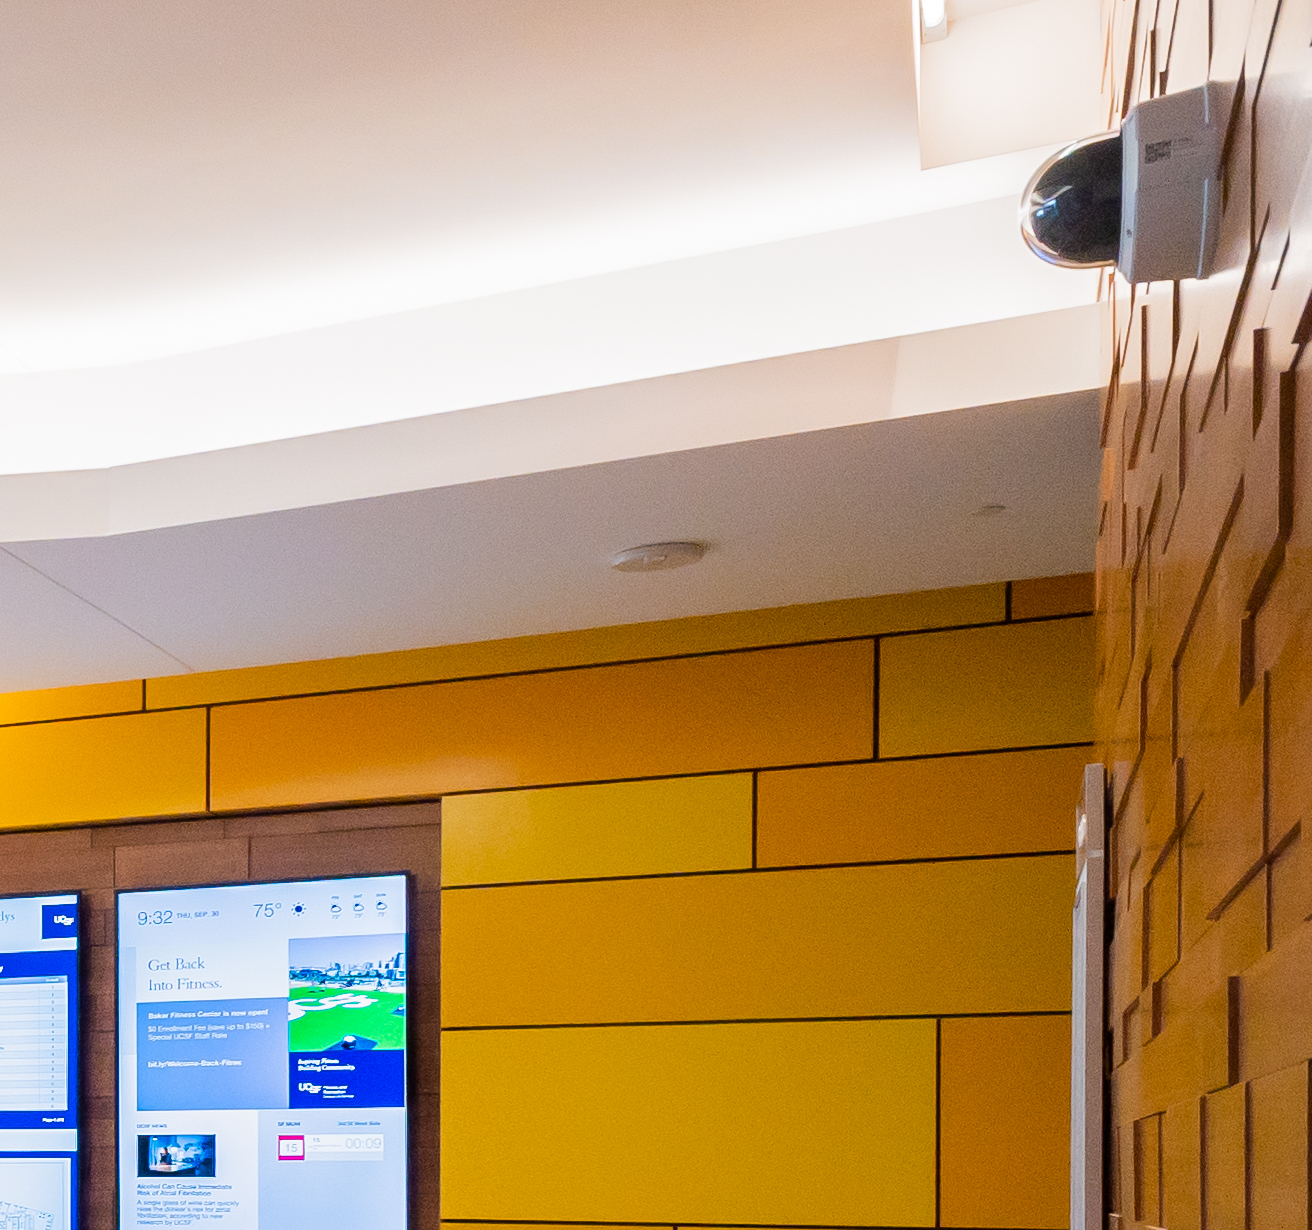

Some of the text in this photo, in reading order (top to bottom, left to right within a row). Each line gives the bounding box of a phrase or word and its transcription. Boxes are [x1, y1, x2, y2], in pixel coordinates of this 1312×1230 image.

[253, 902, 282, 918] 75°
[138, 910, 173, 926] 9:32
[148, 957, 206, 971] Get Back
[149, 978, 222, 991] Into Fitness.
[286, 1144, 298, 1153] 15
[345, 1138, 382, 1149] 00:09
